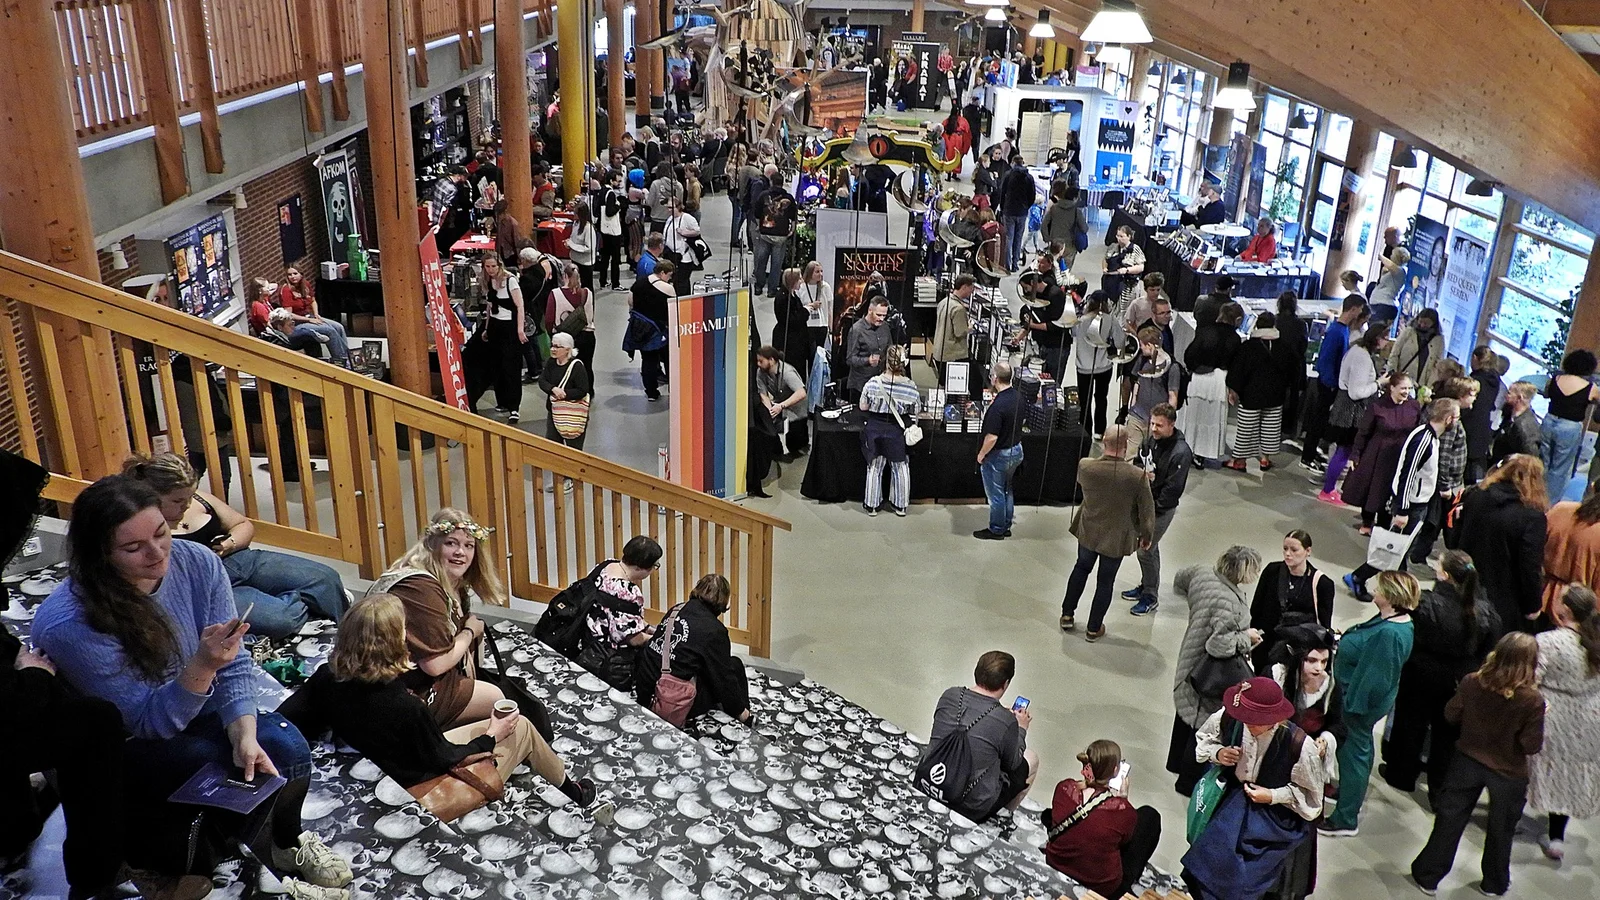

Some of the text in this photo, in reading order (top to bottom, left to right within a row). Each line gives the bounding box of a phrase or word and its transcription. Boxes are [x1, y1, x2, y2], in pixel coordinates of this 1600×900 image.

[919, 51, 930, 101] KRABAT
[322, 160, 346, 182] AFKOM
[843, 252, 905, 264] NATTENS
[846, 261, 903, 272] SKYGGER
[1450, 285, 1469, 302] SERIEN
[1457, 278, 1478, 294] QUEEN
[921, 778, 948, 803] ESL
